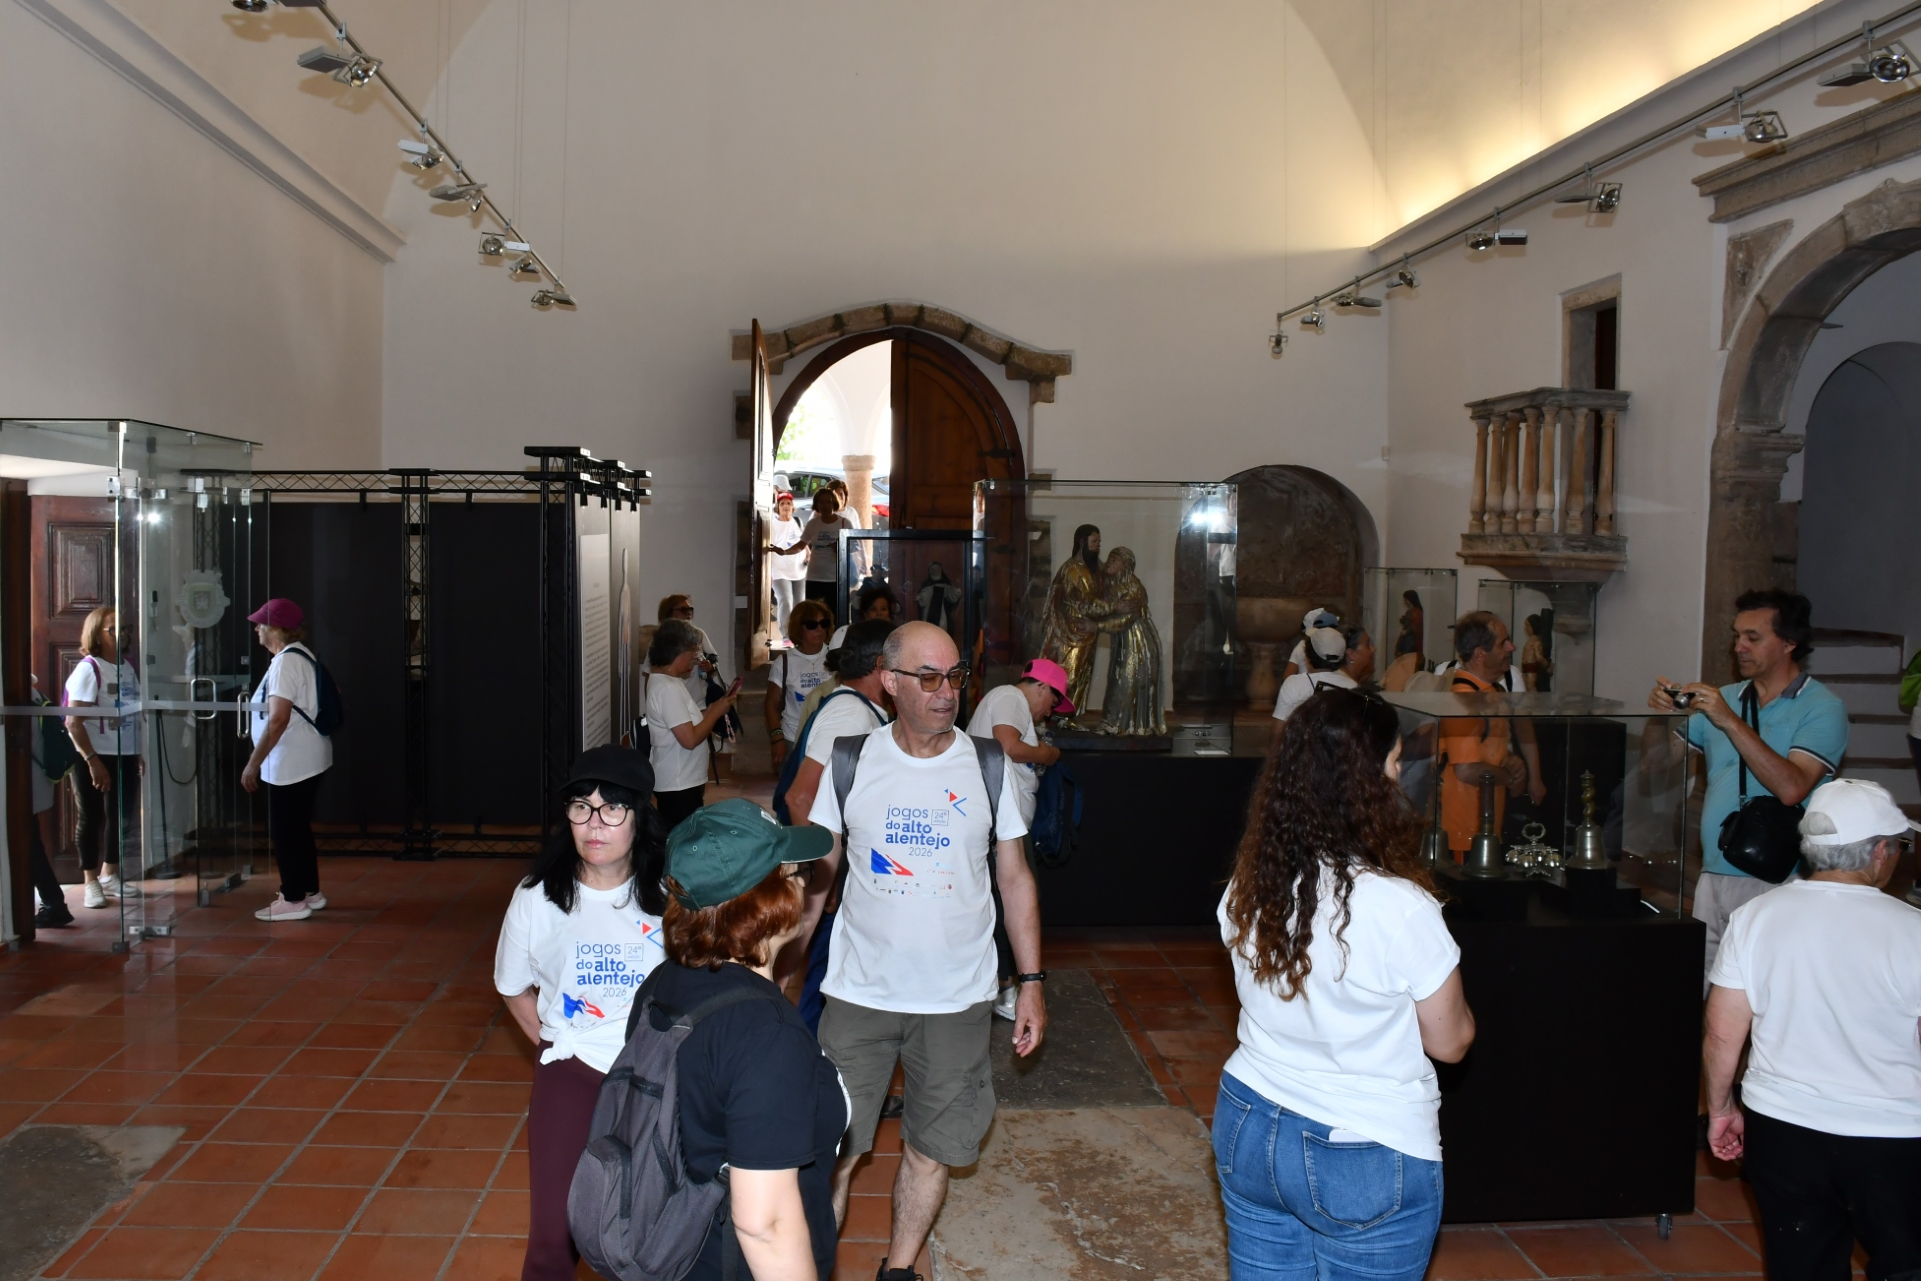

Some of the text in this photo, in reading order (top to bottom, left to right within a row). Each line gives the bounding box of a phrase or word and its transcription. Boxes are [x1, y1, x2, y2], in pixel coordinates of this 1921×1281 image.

[886, 804, 929, 821] jogos
[885, 820, 932, 834] do alto
[885, 832, 950, 849] alentejo
[908, 846, 933, 857] 2026
[575, 941, 621, 959] jogos
[576, 957, 626, 972] do alto
[577, 970, 645, 987] alentejo
[602, 987, 627, 998] 2026
